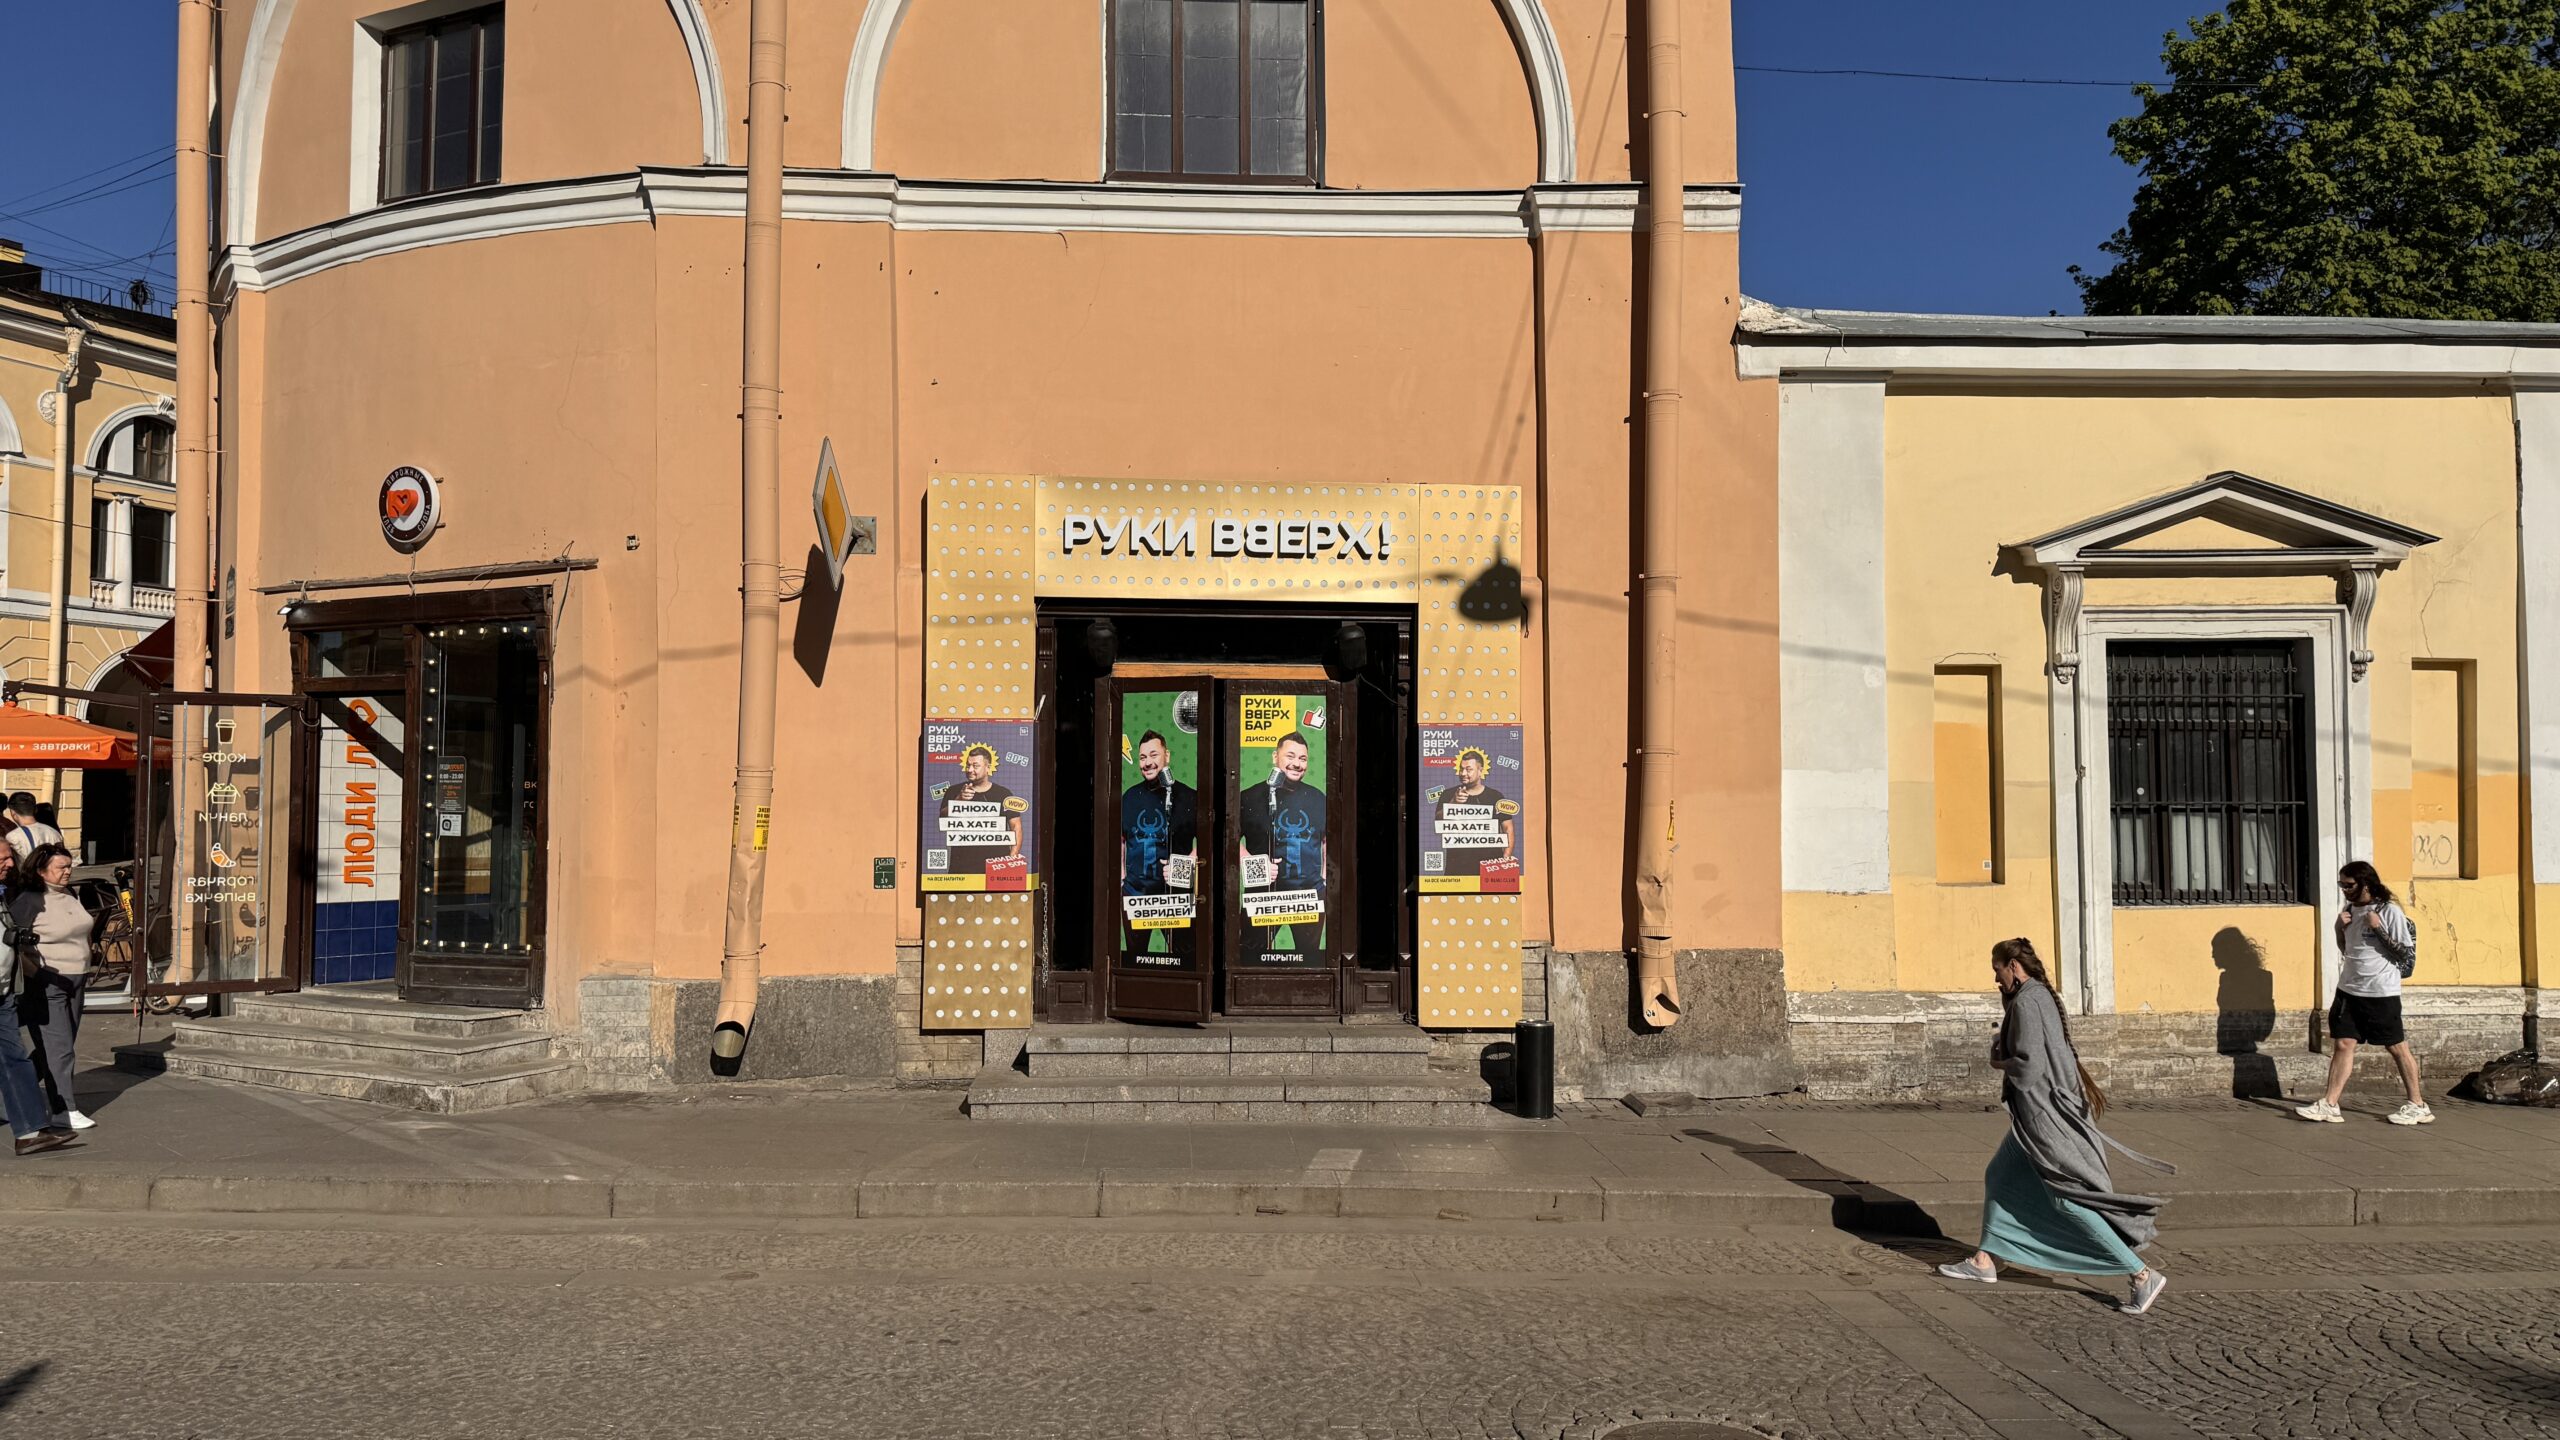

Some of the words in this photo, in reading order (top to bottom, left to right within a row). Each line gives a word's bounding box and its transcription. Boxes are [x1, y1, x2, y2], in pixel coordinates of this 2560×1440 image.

[1063, 515, 1197, 556] РУКИ
[1245, 698, 1282, 708] РУКИ
[1245, 710, 1290, 719] ВВЕРХ
[1245, 720, 1272, 730] БАР
[928, 726, 959, 735] РУКИ
[1423, 730, 1452, 739] РУКИ
[928, 735, 966, 744] ВВЕРХ
[1423, 739, 1459, 748] ВВЕРХ
[32, 743, 91, 752] завтраки
[928, 744, 951, 753] БАР
[1423, 748, 1445, 757] БАР
[951, 805, 998, 813] ДНЮХА
[1008, 800, 1025, 809] WOW
[1499, 802, 1516, 811] WOW
[1446, 807, 1490, 816] ДНЮХА
[343, 782, 377, 888] ЛЮДИ
[948, 834, 957, 842] У
[958, 834, 1011, 842] ЖУКОВА
[1454, 836, 1504, 844] ЖУКОВА
[985, 853, 1026, 864] СКИДКА
[1480, 855, 1519, 866] СКИДКА
[1008, 860, 1027, 868] 50%
[1128, 895, 1190, 907] ОТКРЫТЫ
[1243, 892, 1316, 904] ВОЗВРАЩЕНИЕ
[1134, 905, 1191, 918] ЭВРИДЕЙ
[1255, 903, 1319, 915] ЛЕГЕНДЫ
[1136, 956, 1155, 964] РУКИ
[1155, 957, 1181, 966] ВВЕРХ!
[1260, 954, 1304, 962] ОТКРЫТИЕ
